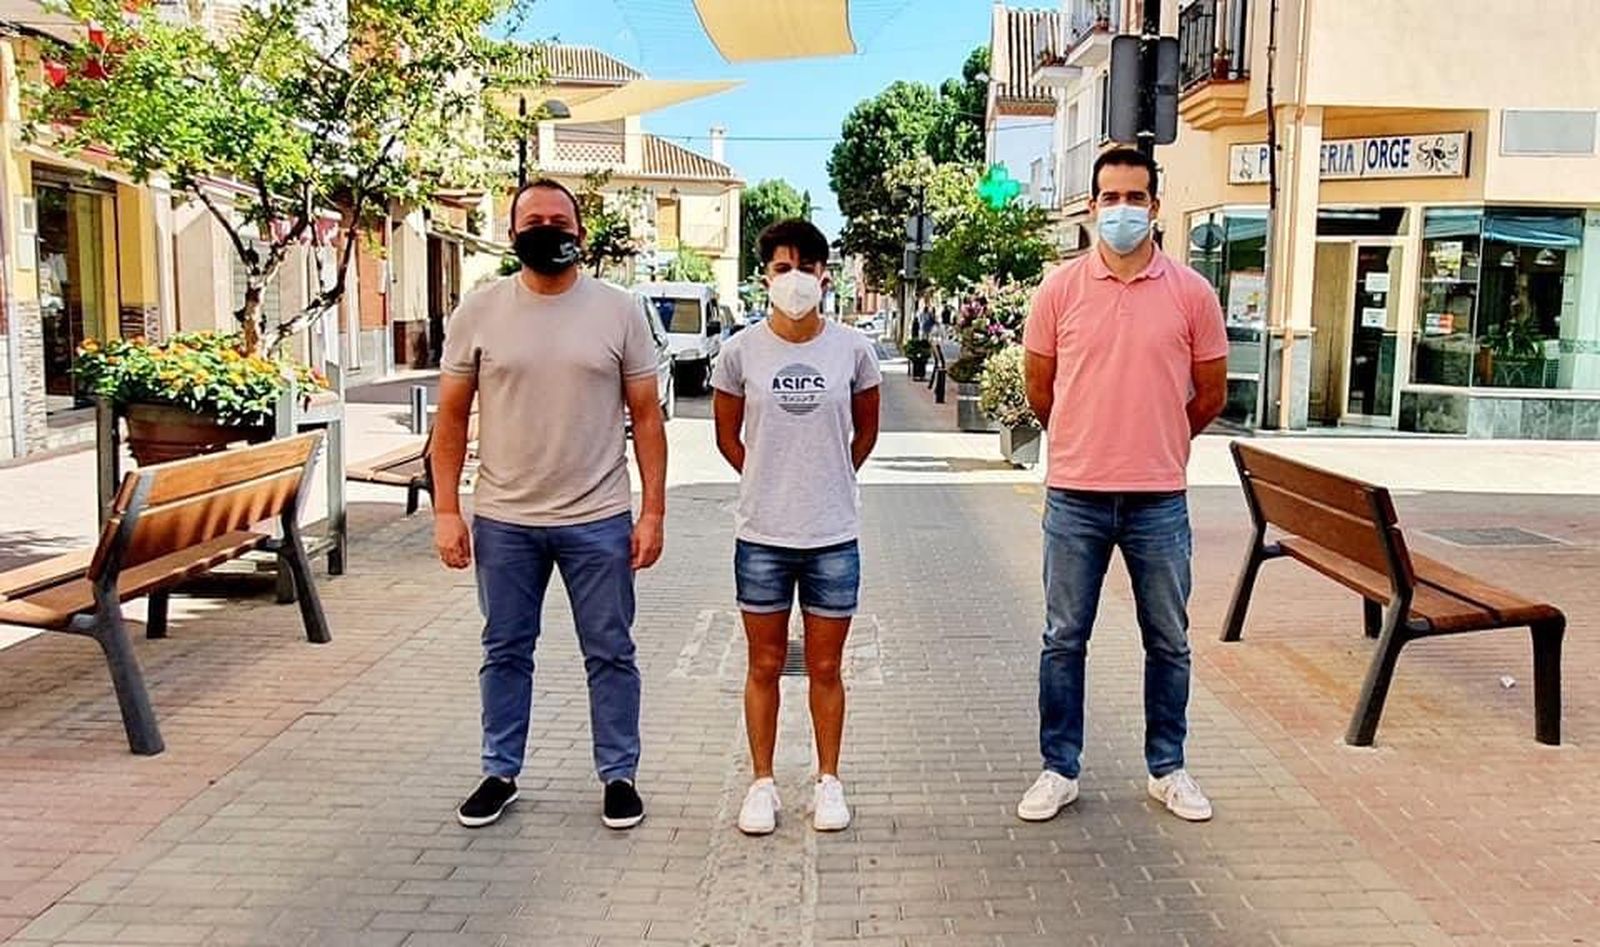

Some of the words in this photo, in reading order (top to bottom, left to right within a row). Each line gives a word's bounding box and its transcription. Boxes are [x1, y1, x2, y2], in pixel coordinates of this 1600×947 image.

[1259, 144, 1355, 174] PERIA
[1360, 138, 1411, 175] JORGE
[772, 376, 826, 390] ASICS
